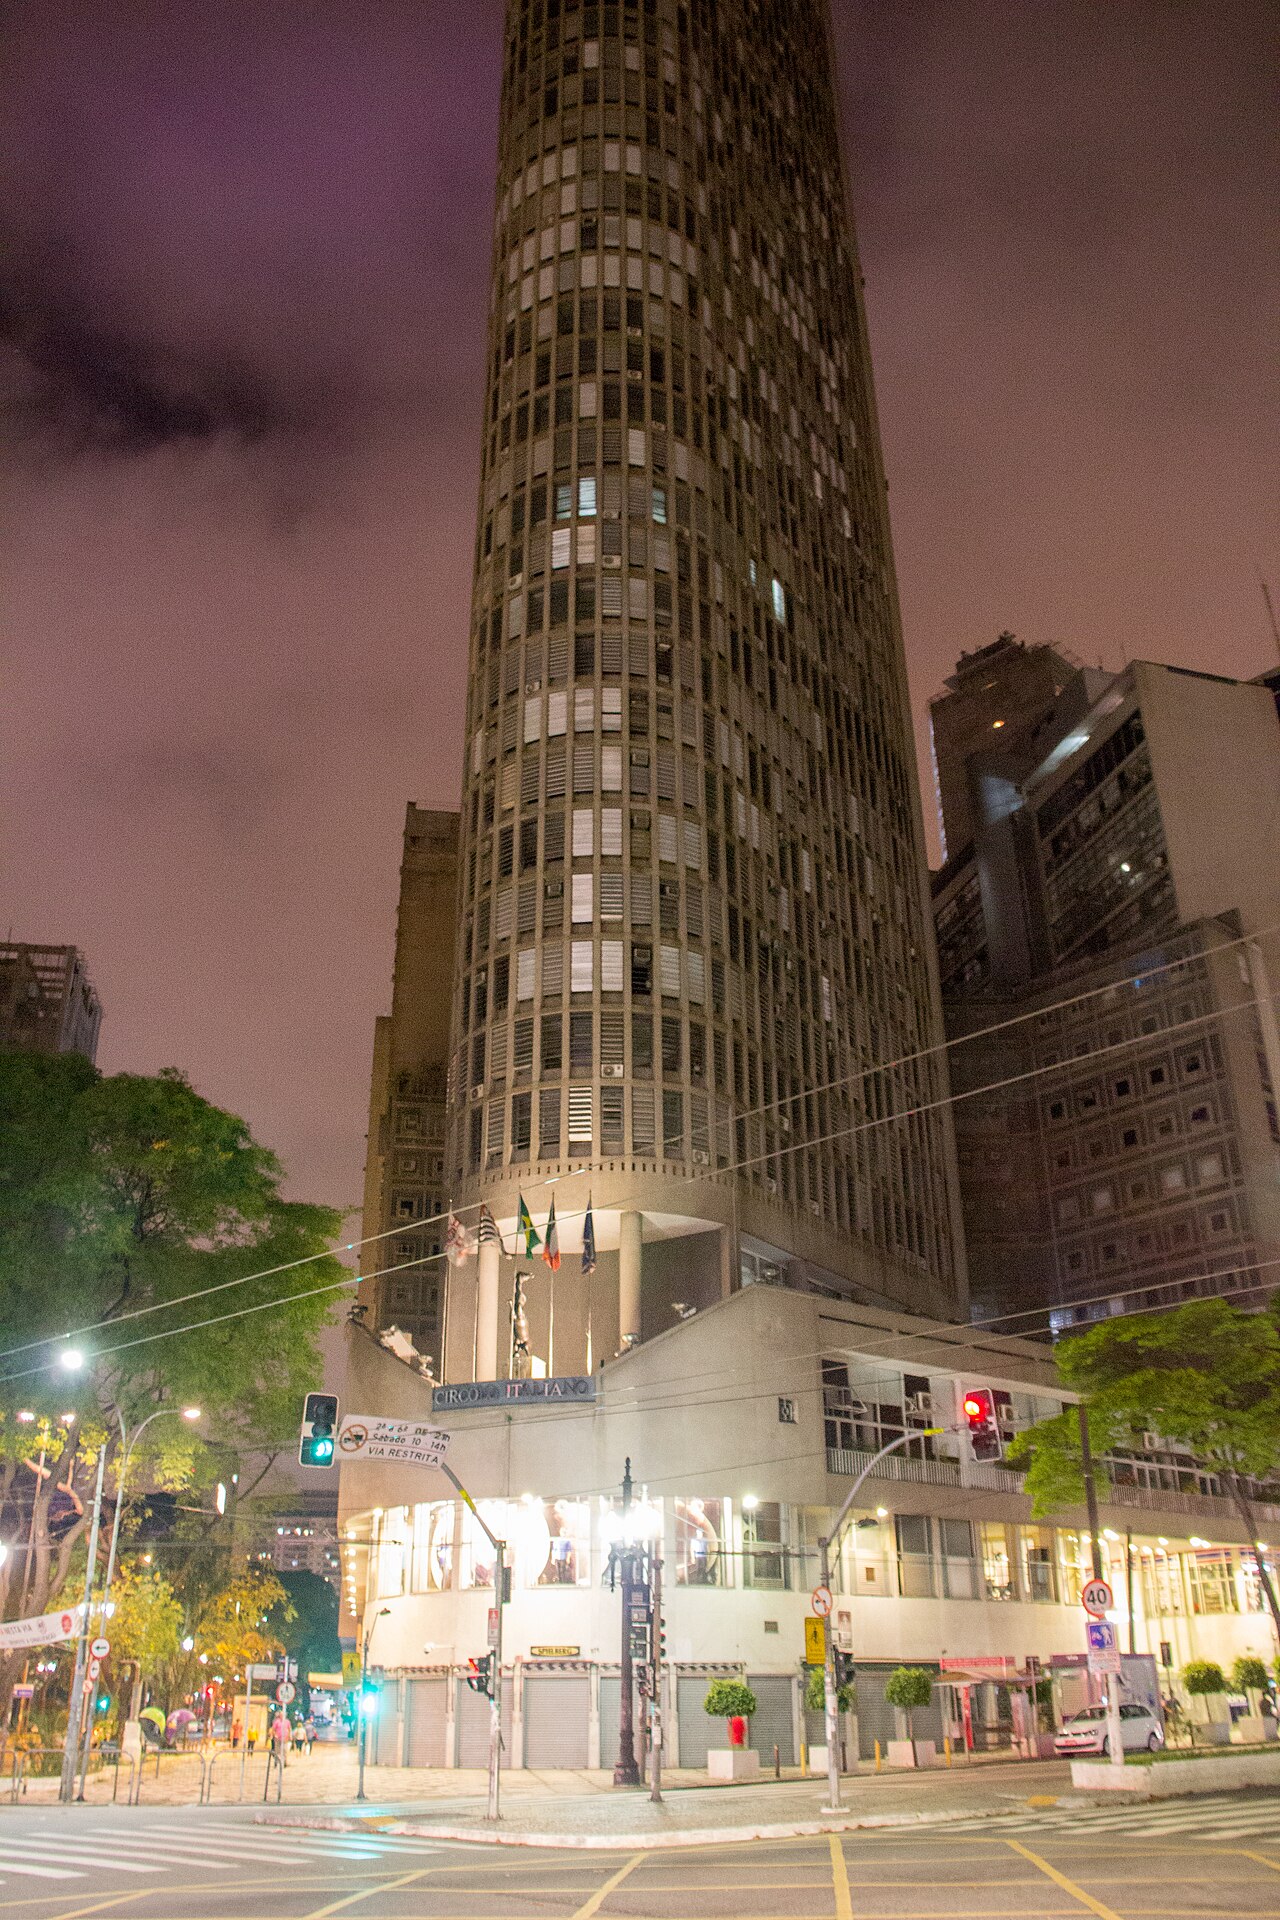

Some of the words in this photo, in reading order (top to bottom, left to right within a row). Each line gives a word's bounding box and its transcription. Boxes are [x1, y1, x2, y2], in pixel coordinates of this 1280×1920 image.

[506, 1379, 589, 1399] ITALIANO
[411, 1437, 421, 1446] 10
[430, 1441, 446, 1452] 14h
[369, 1447, 385, 1456] VIA
[388, 1449, 439, 1464] RESTRITA
[1087, 1588, 1107, 1605] 40
